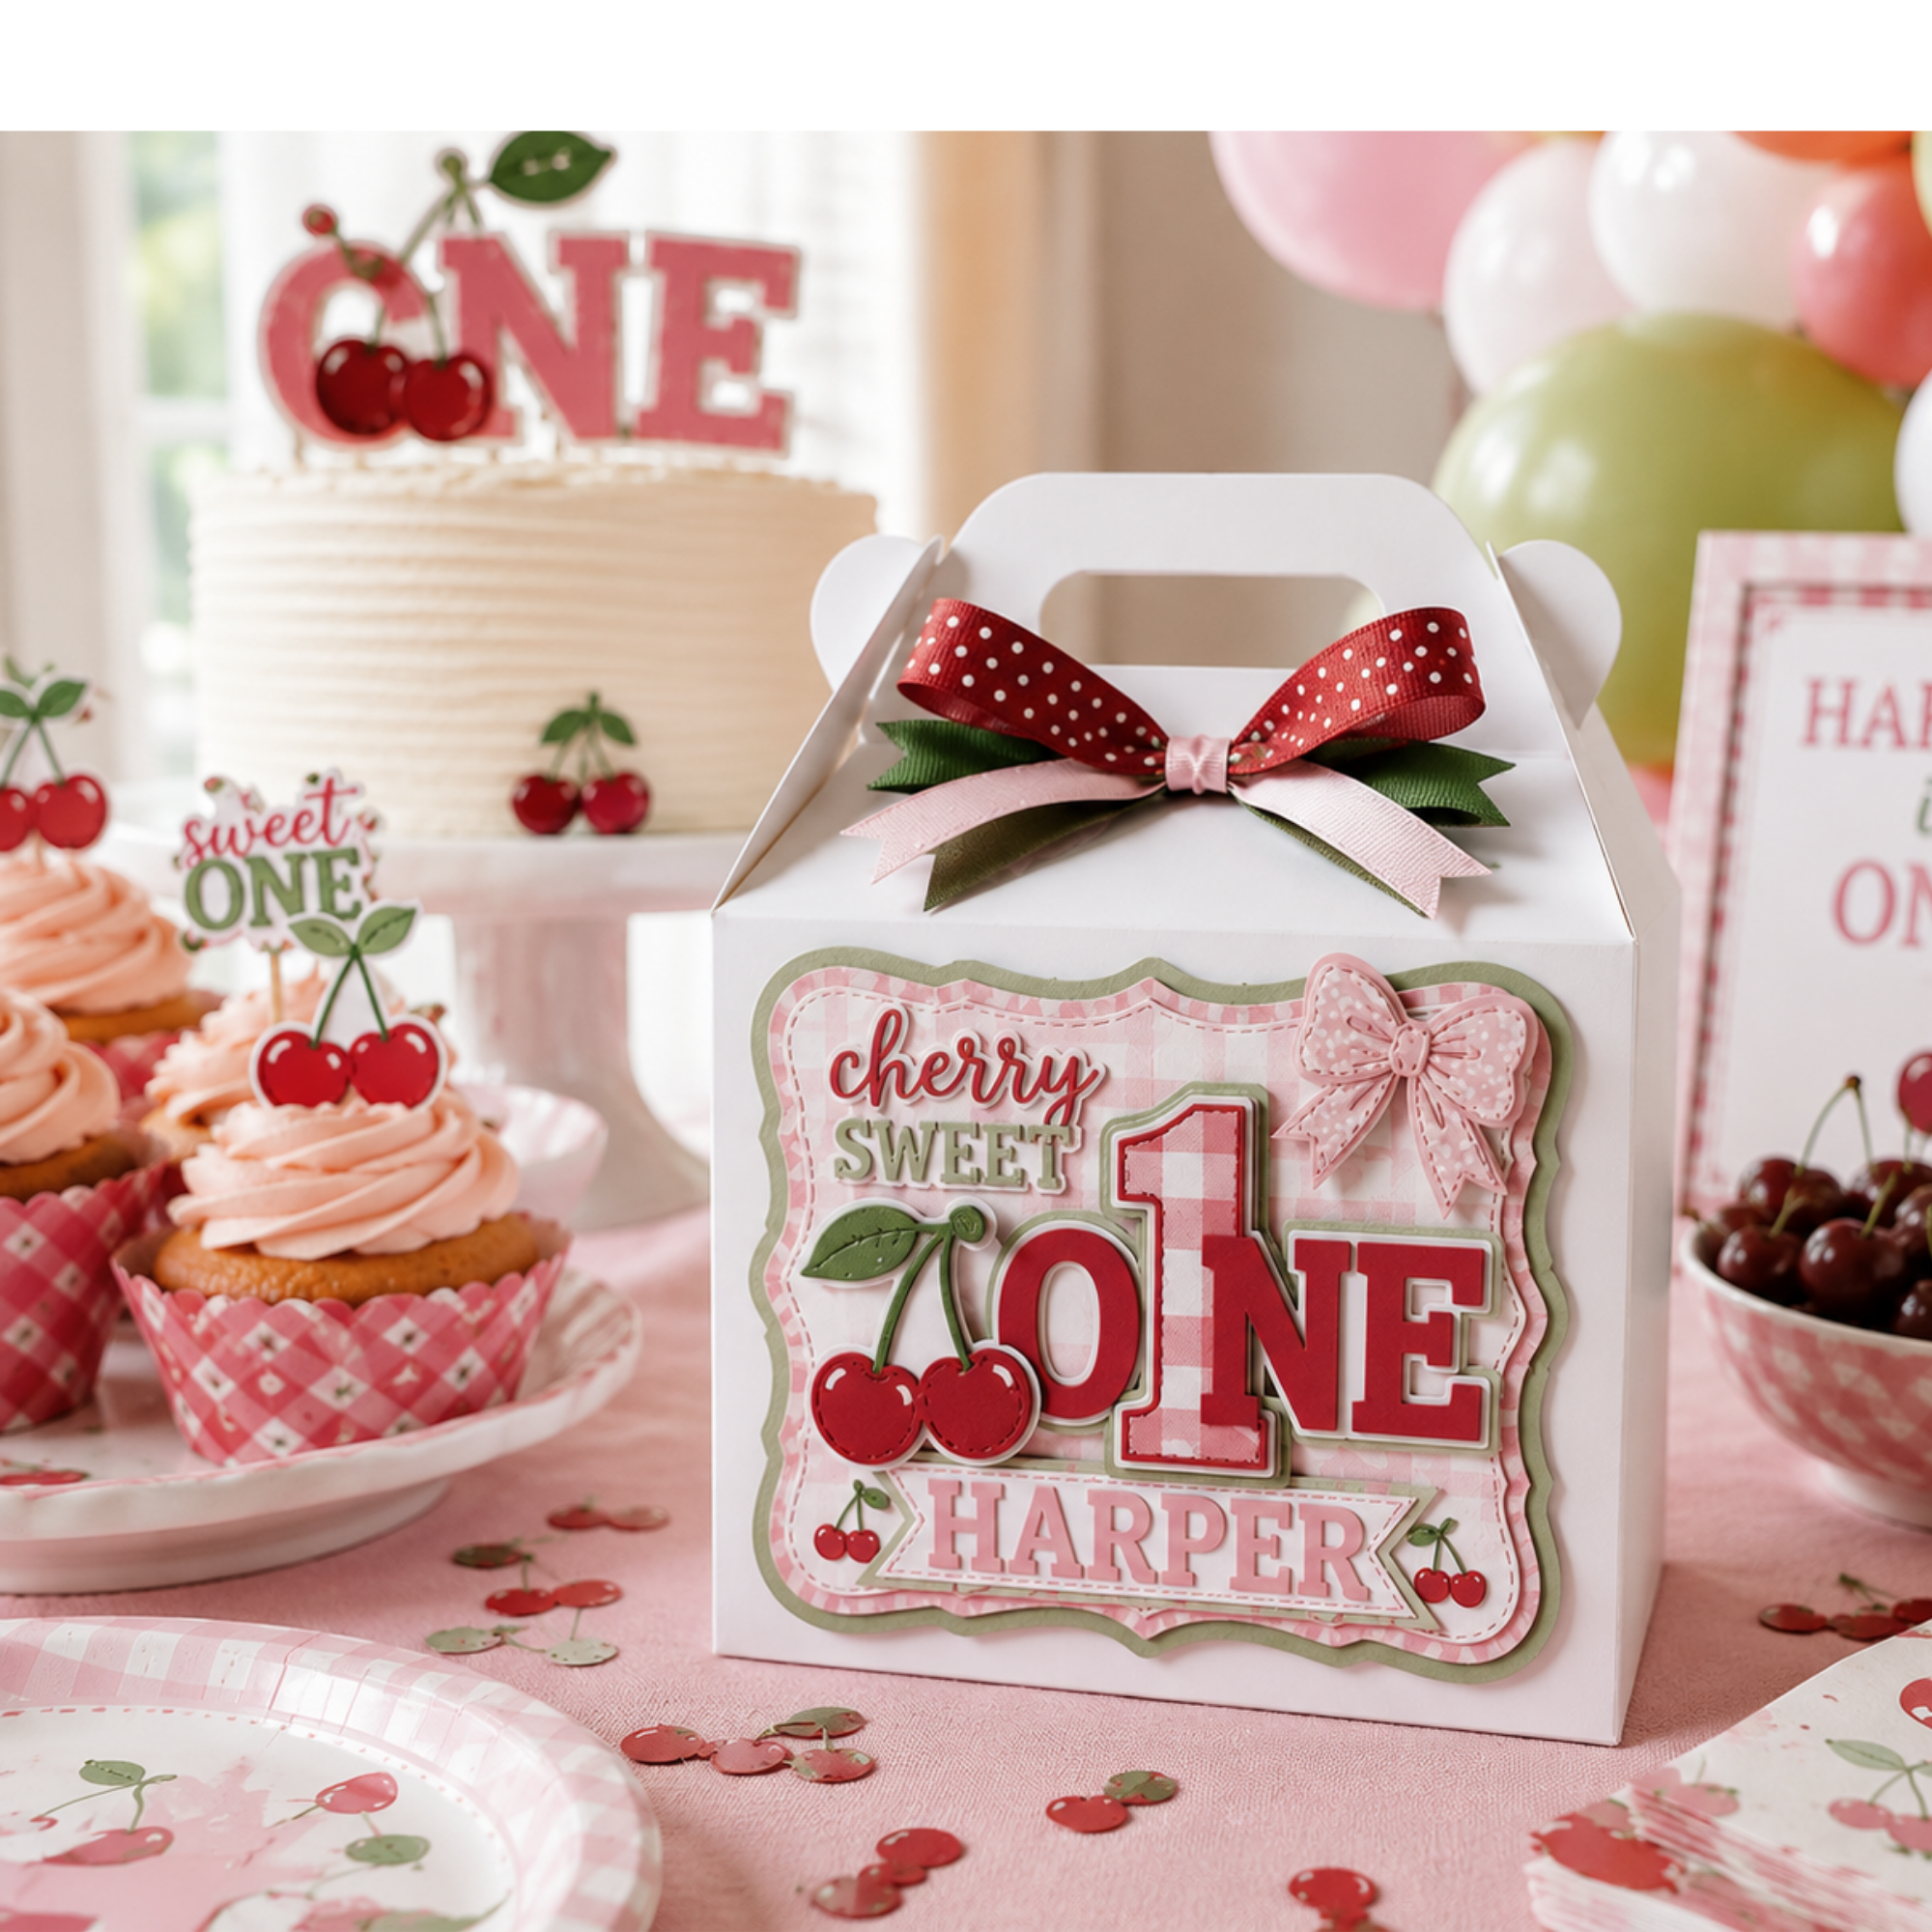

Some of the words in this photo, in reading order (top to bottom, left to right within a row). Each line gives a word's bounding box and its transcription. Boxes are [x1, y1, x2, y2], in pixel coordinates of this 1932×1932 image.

[184, 776, 359, 867] sweet
[184, 846, 362, 931] ONE
[829, 1008, 1100, 1126] cherry
[834, 1118, 1071, 1190] SWEET
[997, 1227, 1485, 1442] ONE
[927, 1478, 1370, 1602] HARPER
